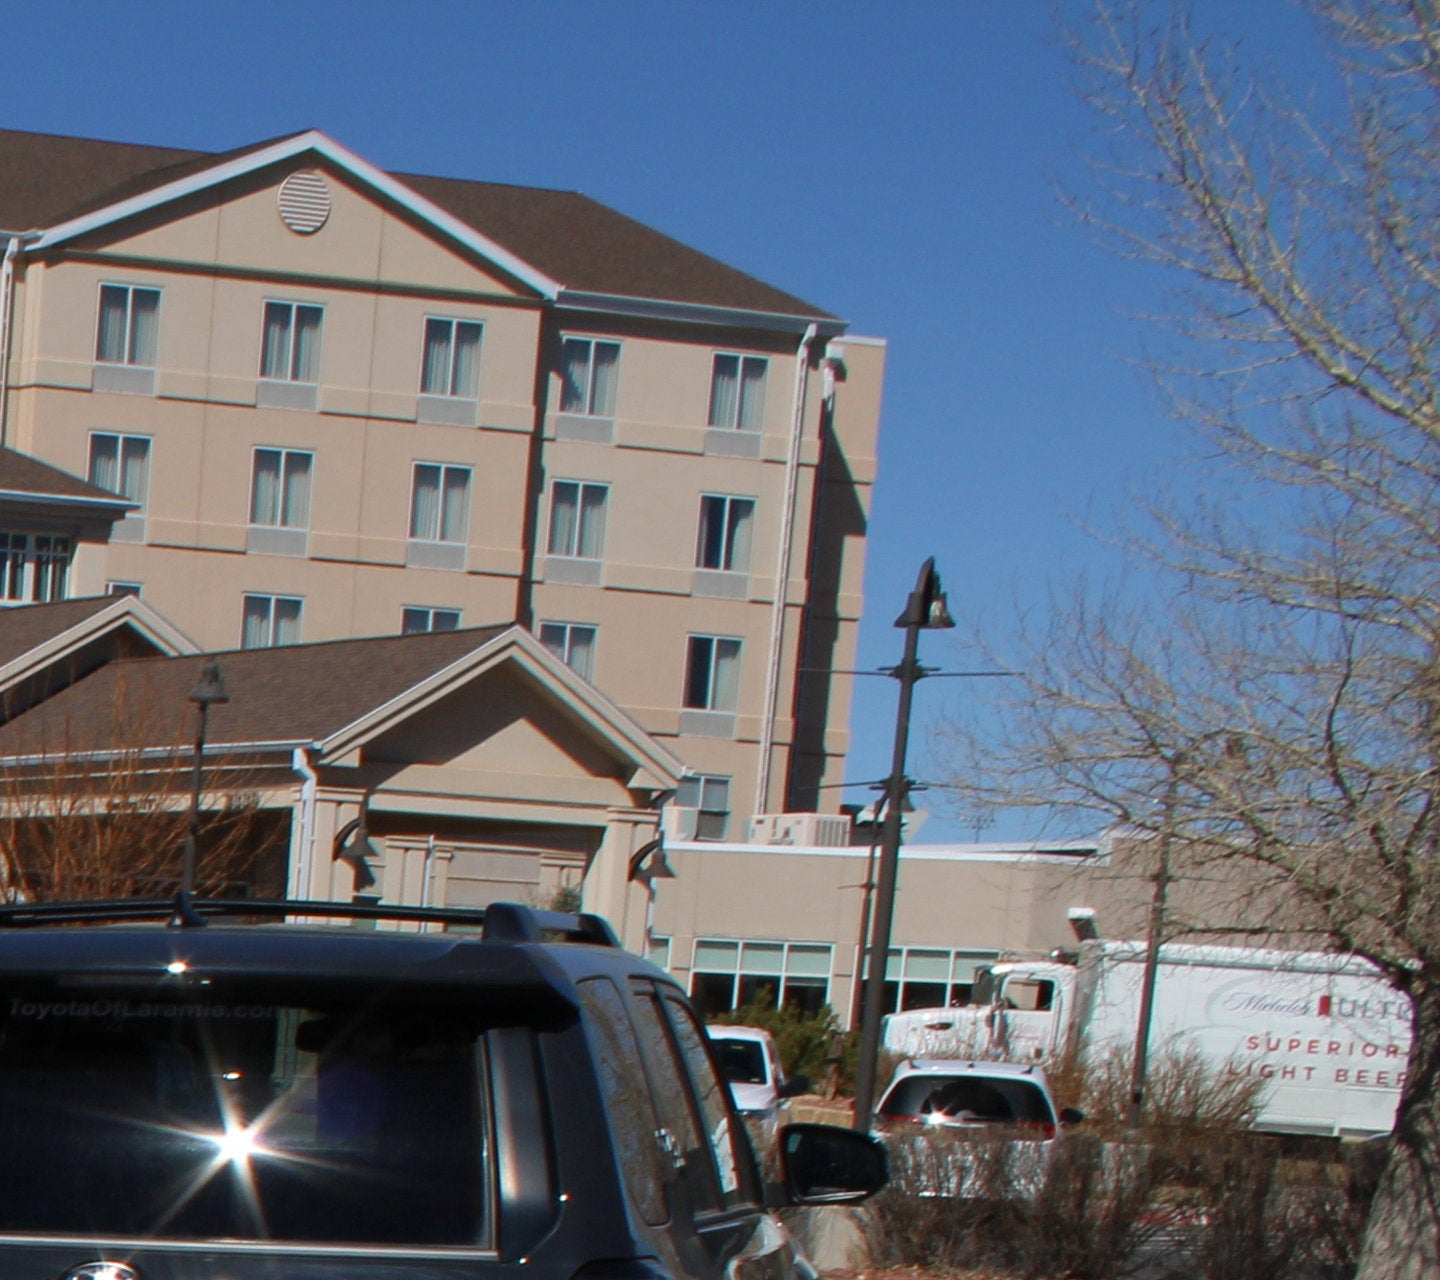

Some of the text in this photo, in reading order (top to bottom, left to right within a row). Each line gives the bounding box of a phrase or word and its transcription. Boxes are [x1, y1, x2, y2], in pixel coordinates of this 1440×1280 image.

[9, 998, 279, 1020] ToyotaOfLaramie.co
[1337, 998, 1413, 1019] ULTR
[1246, 1035, 1399, 1058] SUPERIOR
[1228, 1061, 1316, 1081] LIGHT
